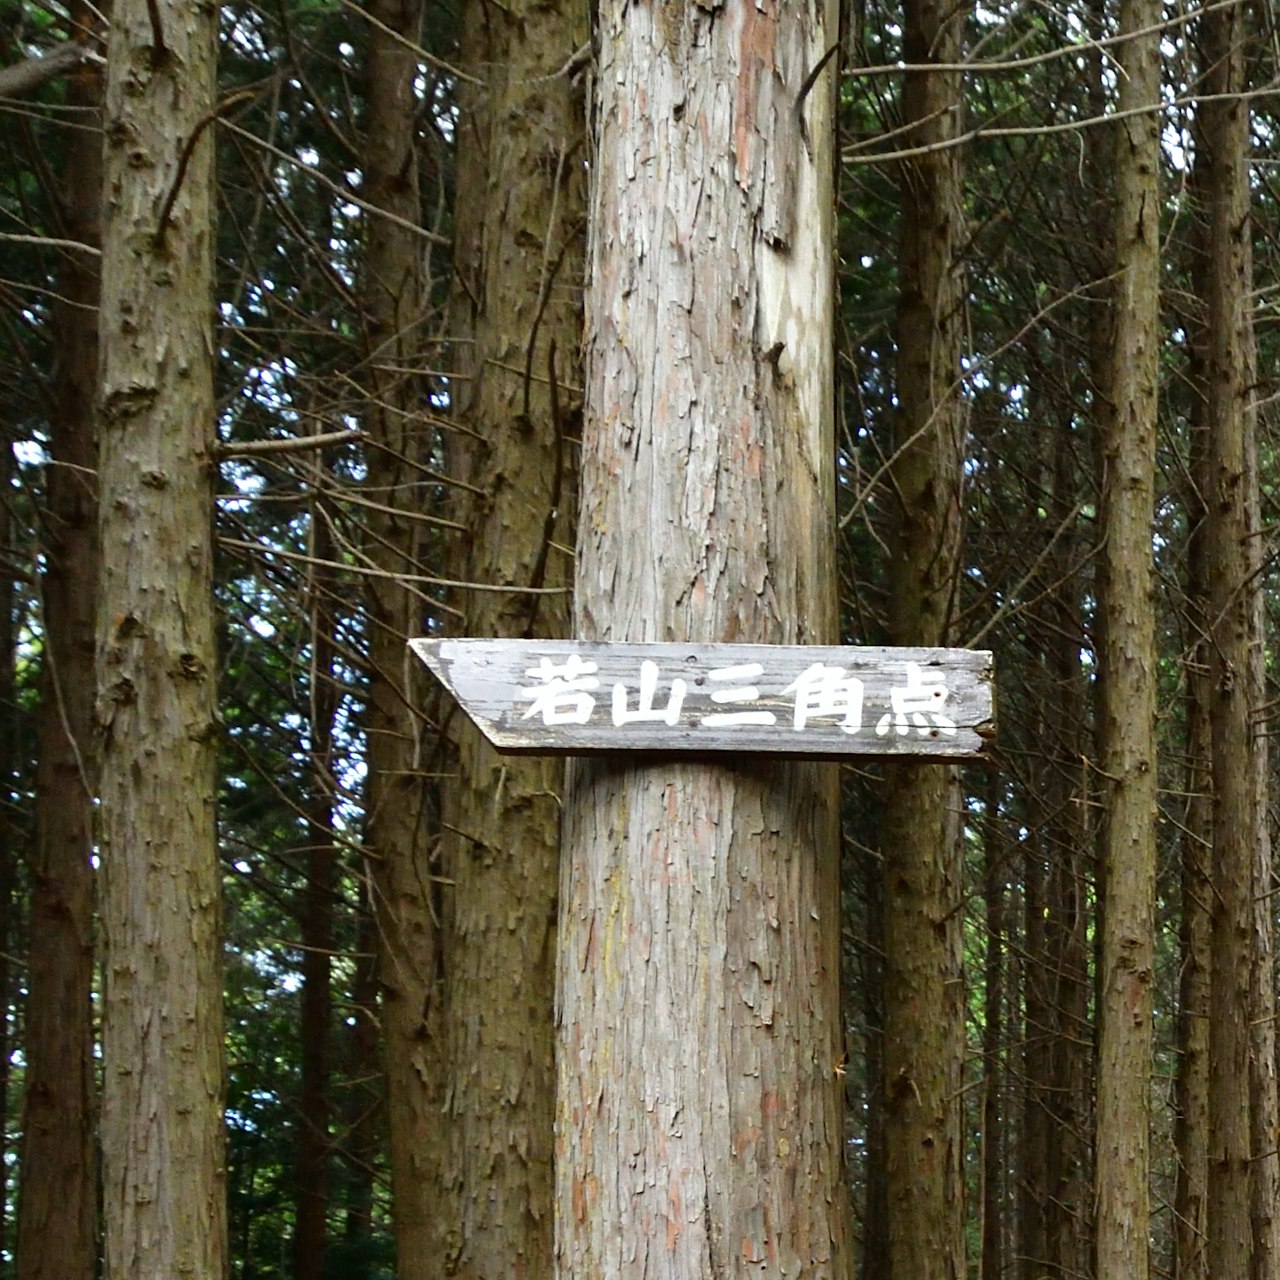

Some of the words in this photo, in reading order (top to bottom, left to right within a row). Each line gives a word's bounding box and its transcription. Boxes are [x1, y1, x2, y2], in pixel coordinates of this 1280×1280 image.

[521, 654, 957, 736] 若山三角点
